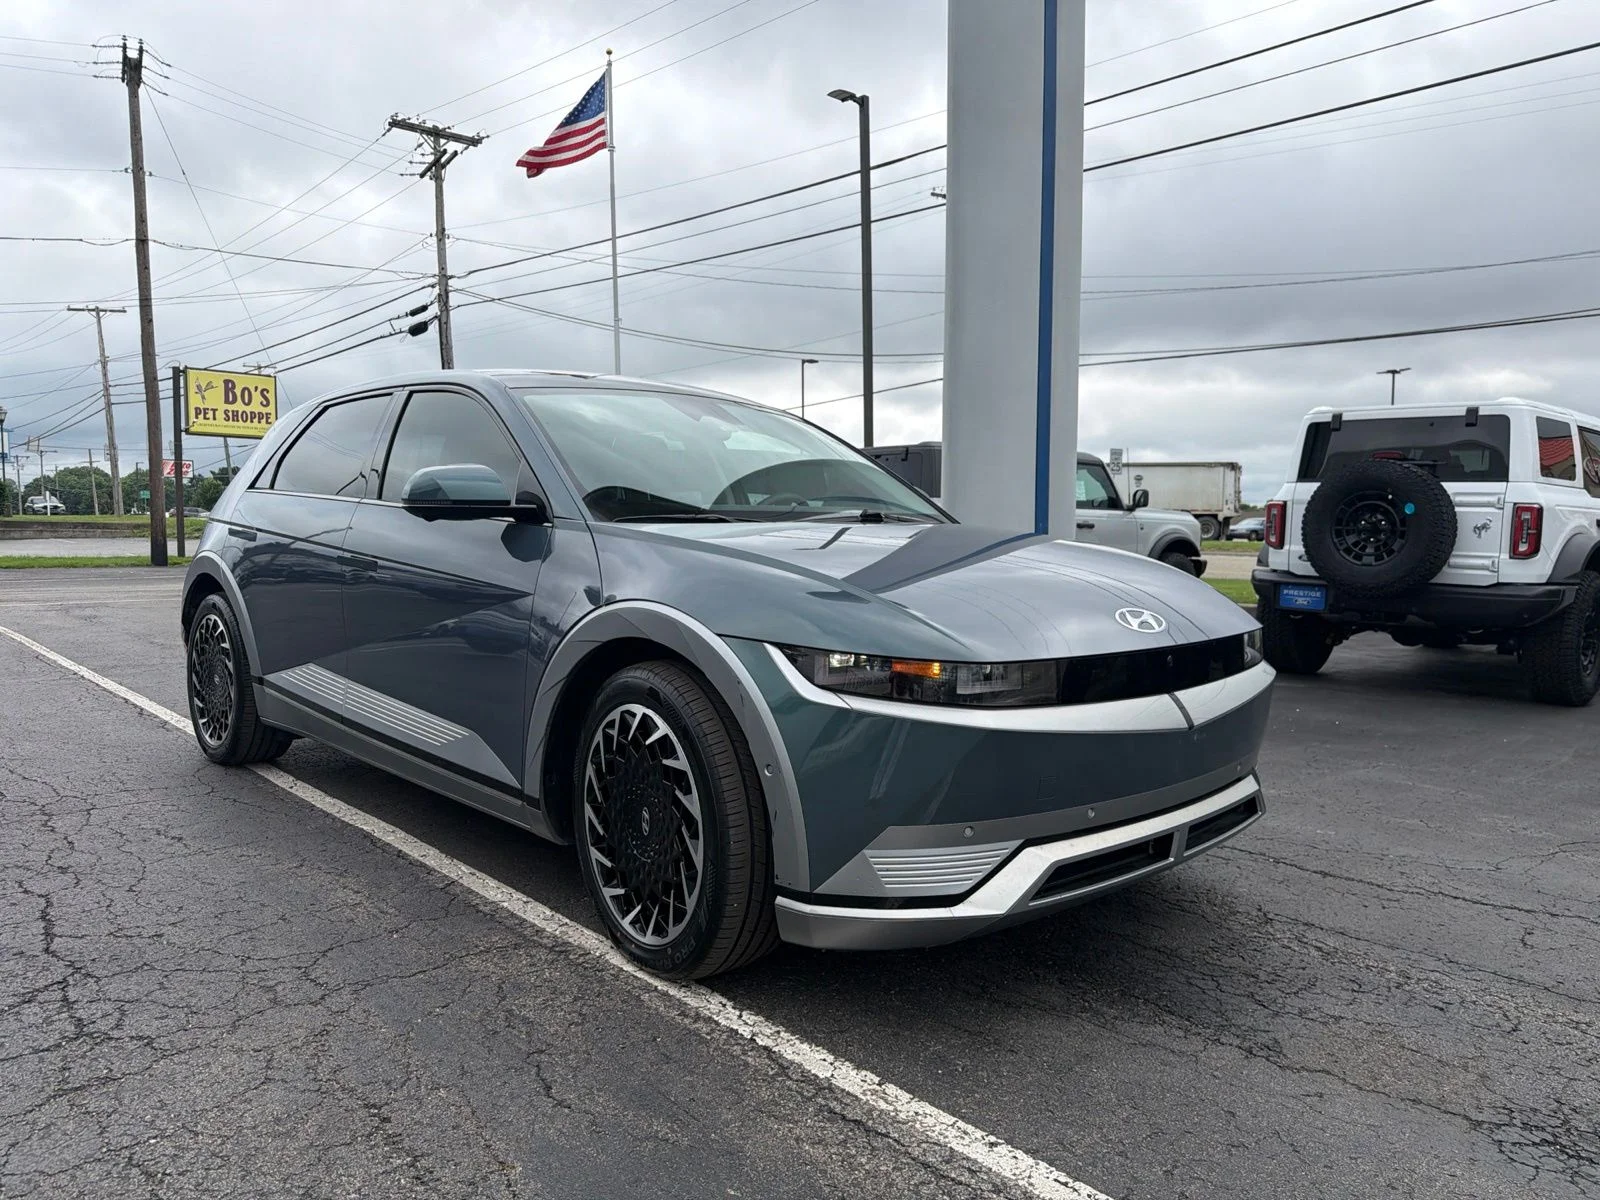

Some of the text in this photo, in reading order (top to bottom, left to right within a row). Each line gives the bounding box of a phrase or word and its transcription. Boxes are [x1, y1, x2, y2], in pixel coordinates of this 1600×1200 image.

[194, 407, 272, 425] PET SHOPPE
[1111, 462, 1121, 472] 25
[1283, 589, 1321, 598] PRESTIGE
